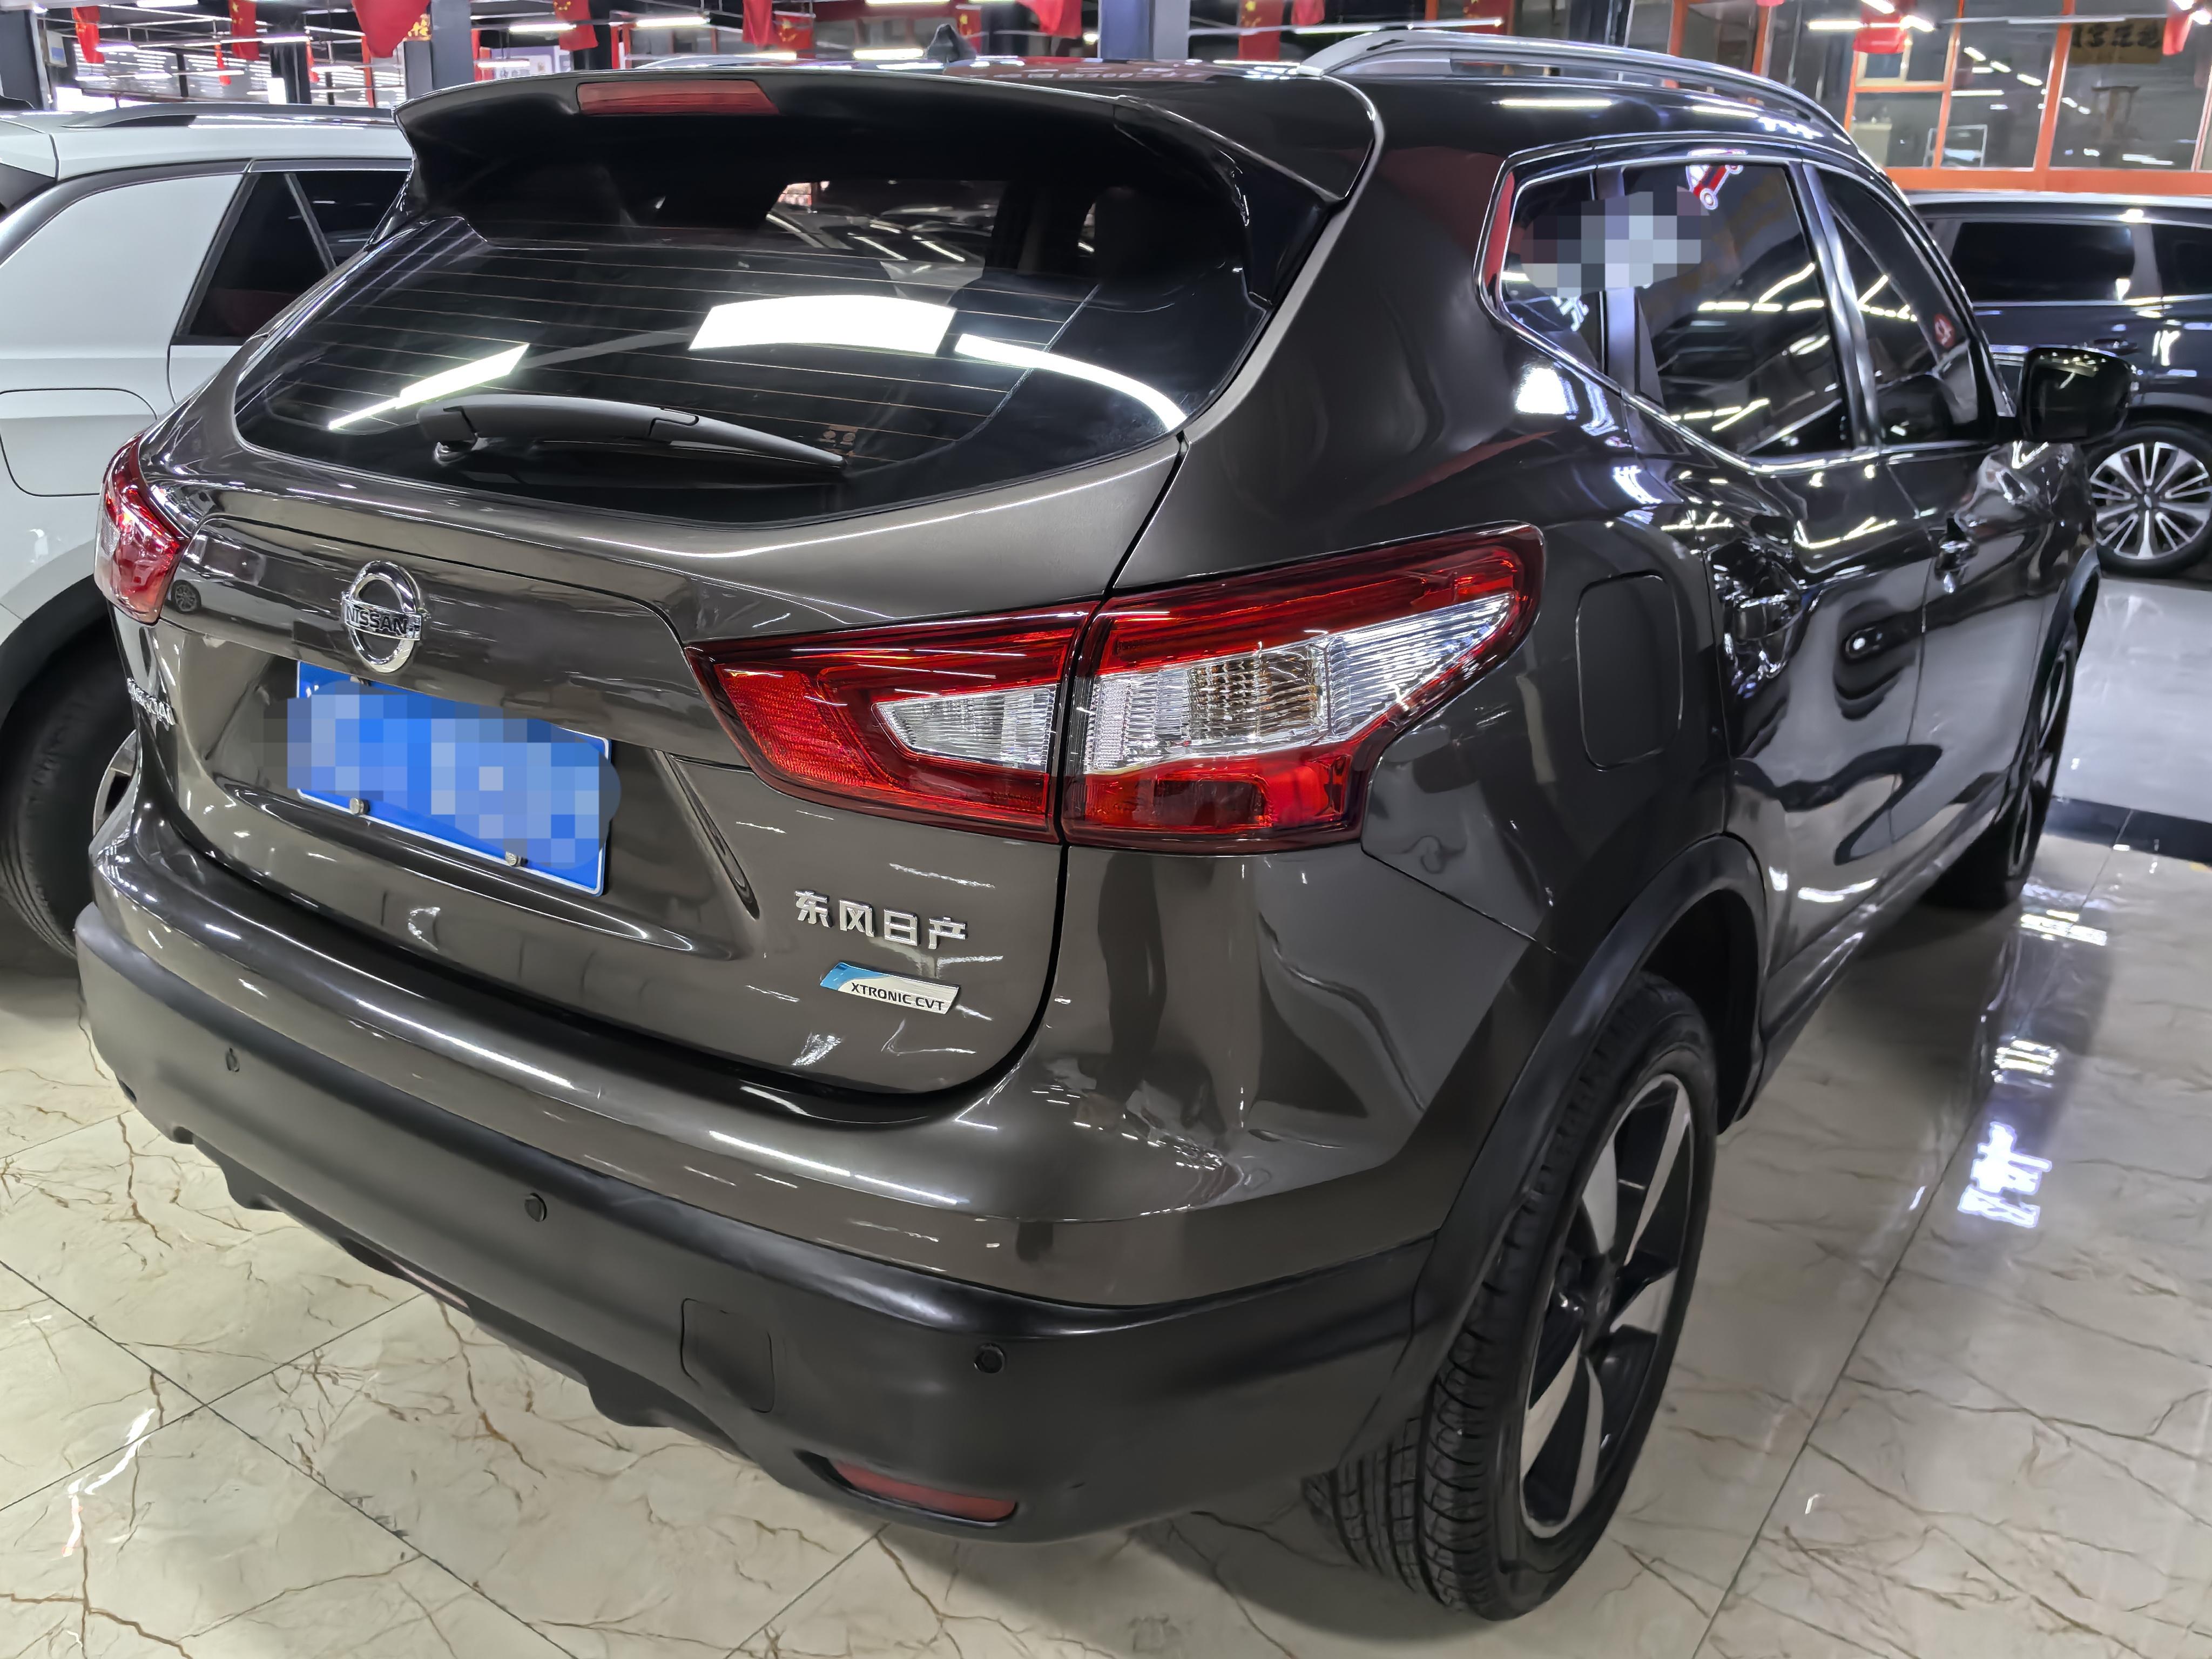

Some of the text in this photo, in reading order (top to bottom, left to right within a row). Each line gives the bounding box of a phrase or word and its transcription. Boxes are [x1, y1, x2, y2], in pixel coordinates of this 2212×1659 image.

[346, 604, 408, 636] NISSAN
[794, 890, 966, 950] 东风日产
[851, 982, 945, 1011] XTRONIC CVT
